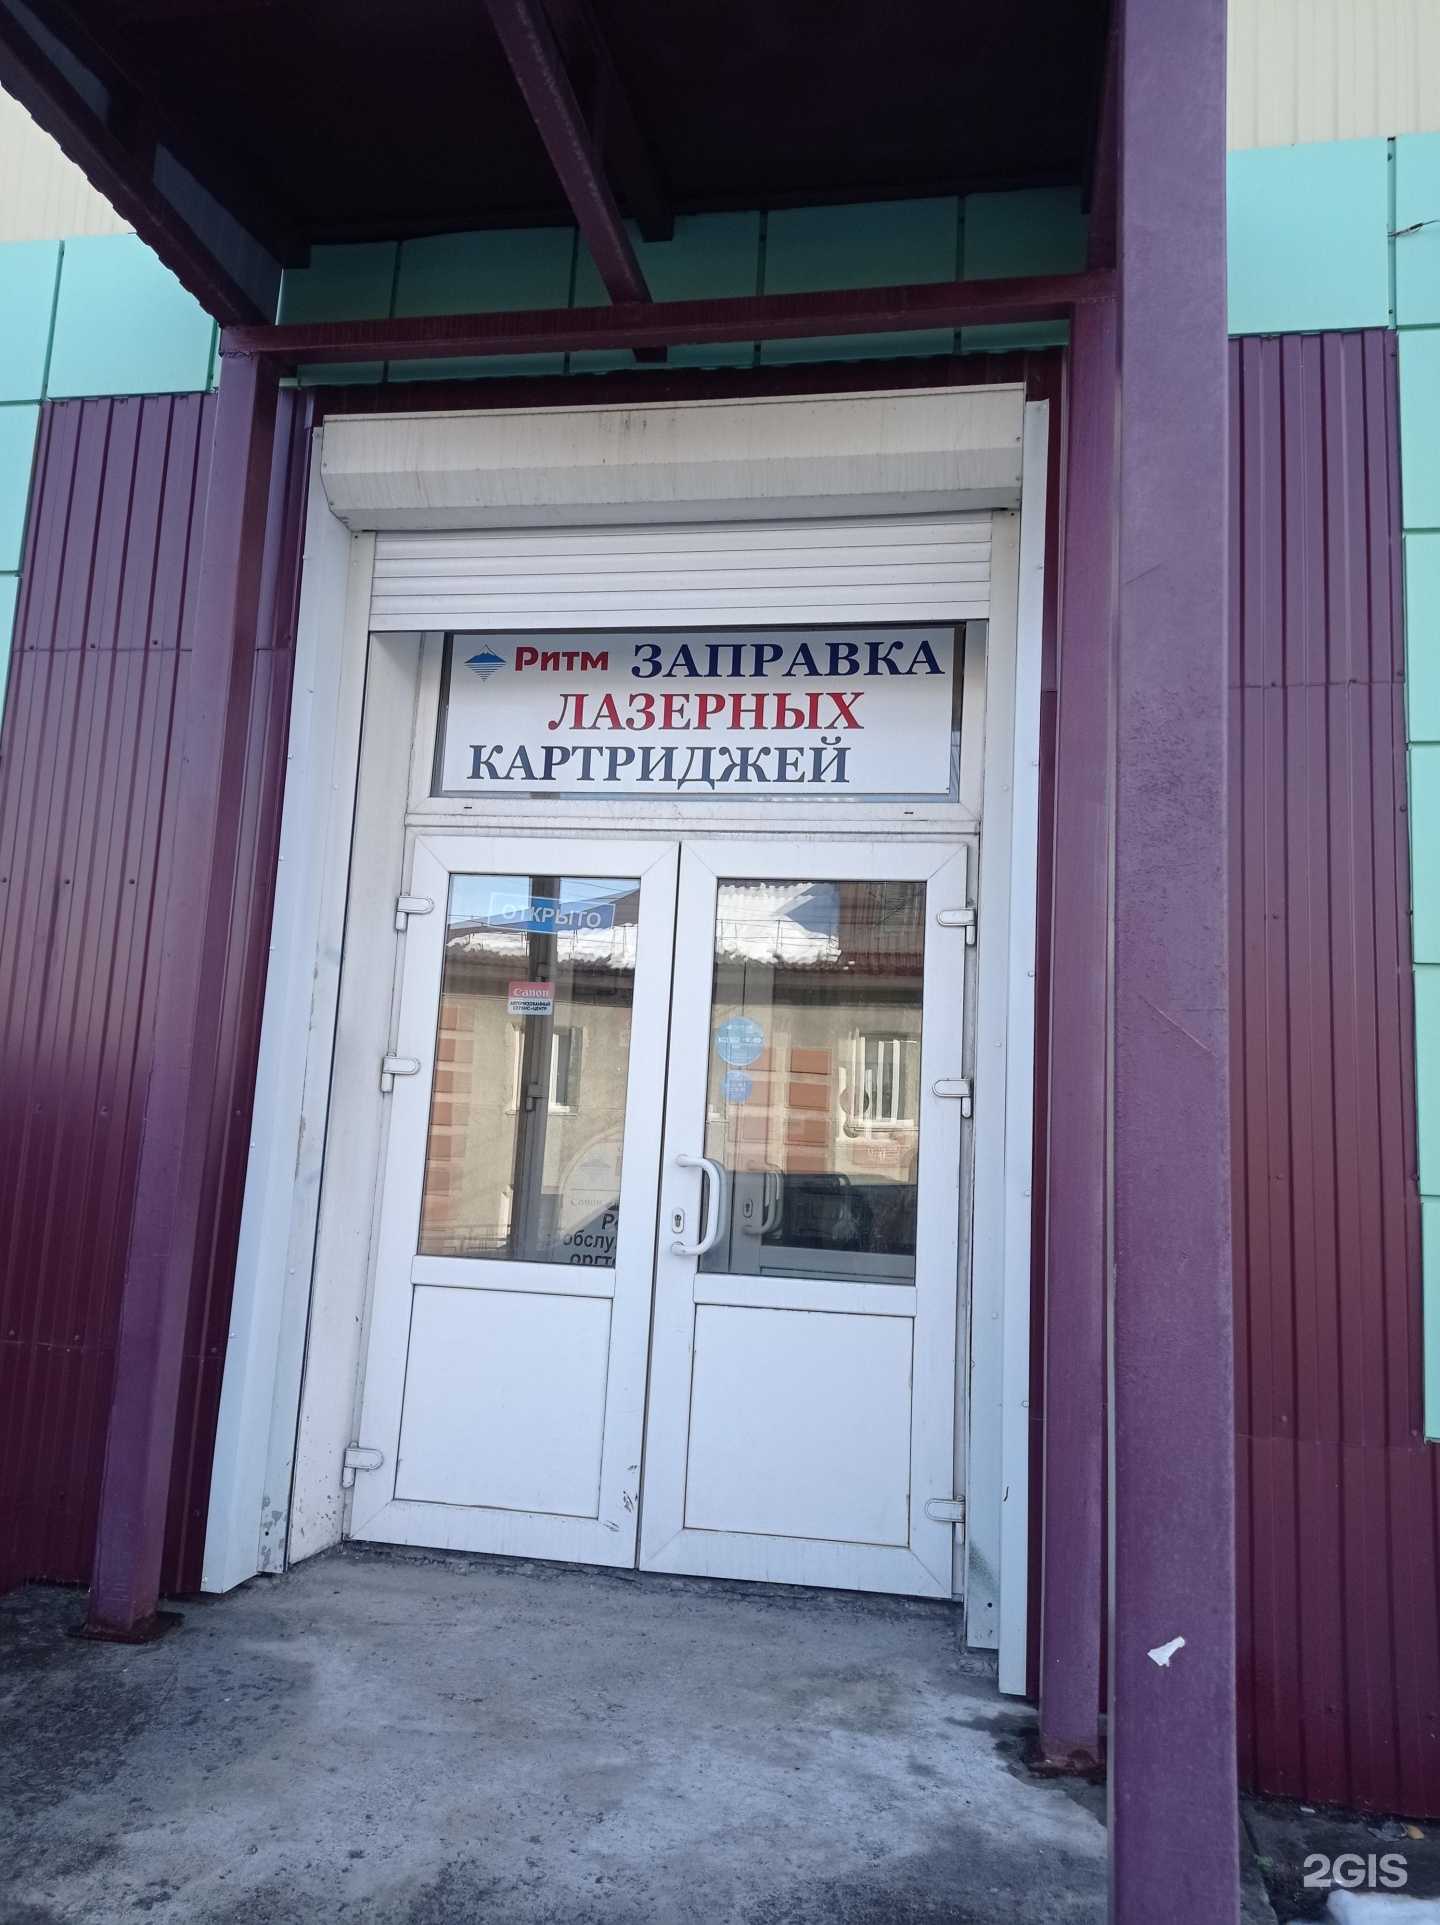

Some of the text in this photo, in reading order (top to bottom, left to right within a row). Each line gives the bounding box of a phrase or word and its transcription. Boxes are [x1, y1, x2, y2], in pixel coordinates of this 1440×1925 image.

[515, 646, 609, 672] Ритм
[631, 640, 946, 678] ЗАПРАВКА
[548, 692, 865, 732] ЛАЗЕРНЫХ
[466, 736, 852, 791] КАРТРИДЖЕЙ
[503, 903, 602, 928] ОТКРЫТО
[513, 988, 550, 998] Canon
[563, 1229, 617, 1254] обслу
